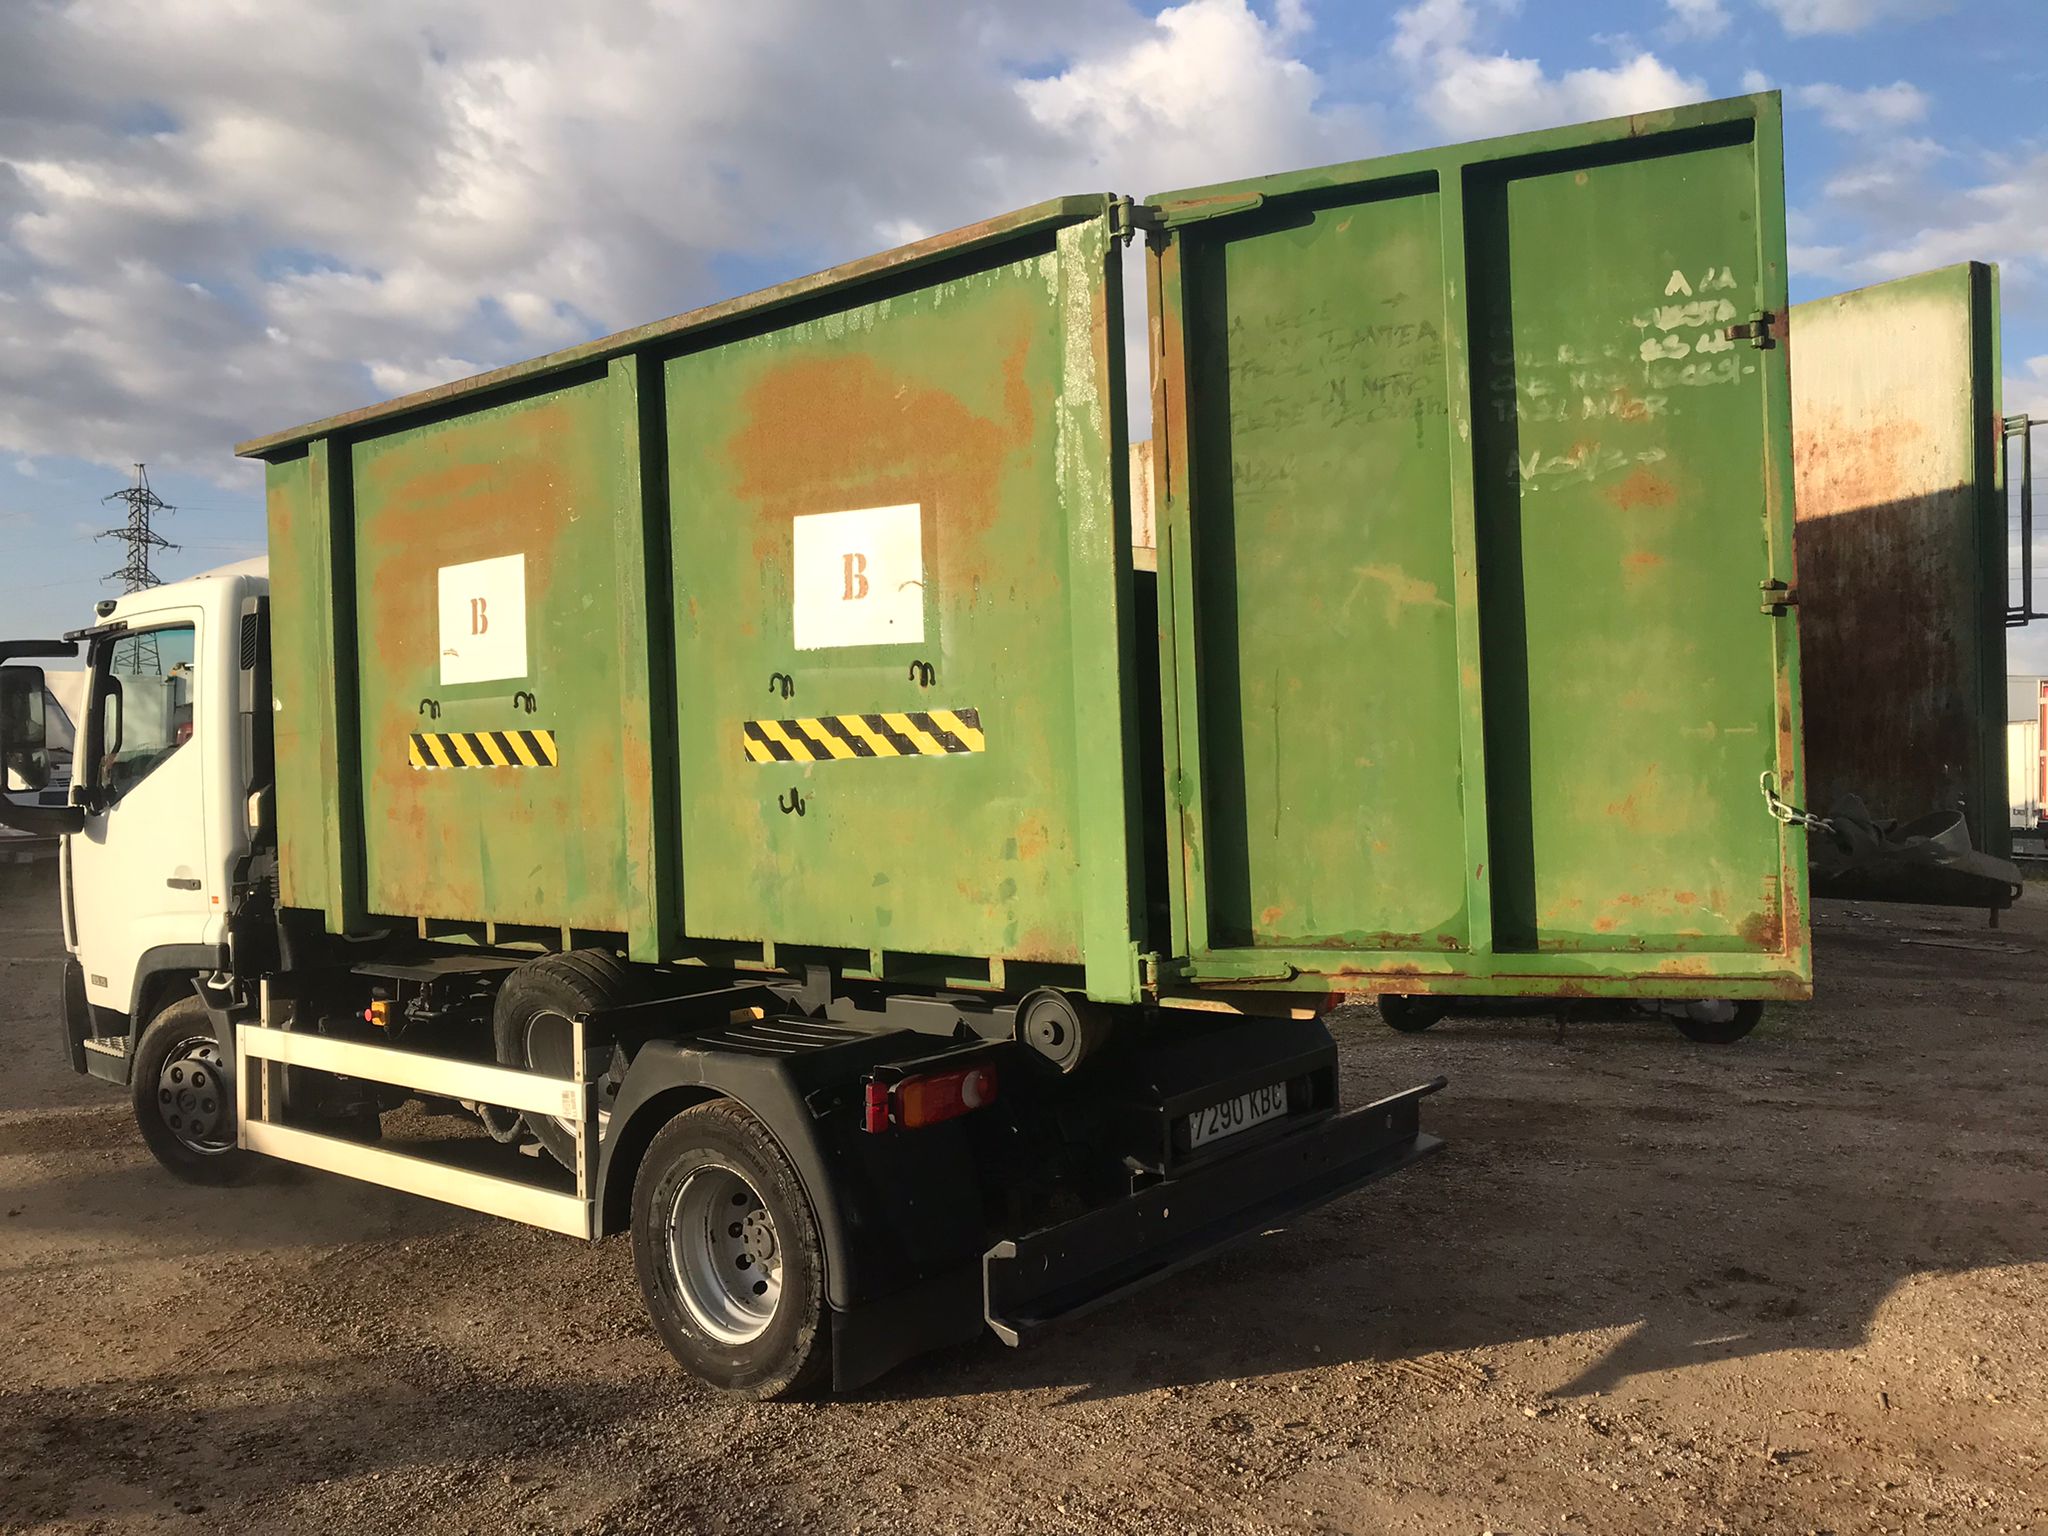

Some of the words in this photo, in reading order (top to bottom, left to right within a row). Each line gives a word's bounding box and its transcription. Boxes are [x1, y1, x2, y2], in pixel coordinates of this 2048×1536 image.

[842, 553, 869, 600] B
[470, 597, 488, 635] B
[1194, 1098, 1243, 1140] 7290
[1249, 1082, 1282, 1119] KBC
